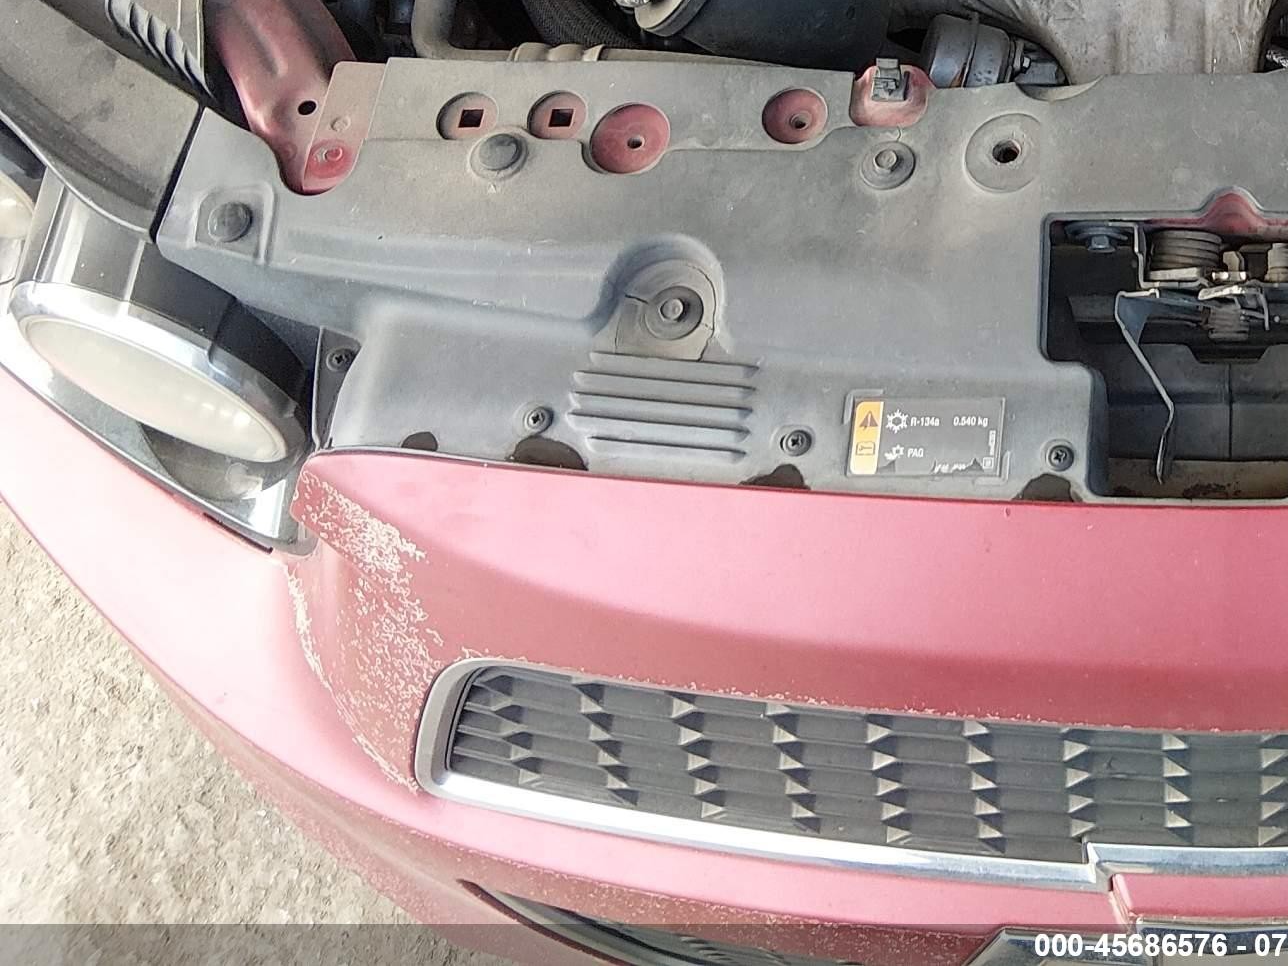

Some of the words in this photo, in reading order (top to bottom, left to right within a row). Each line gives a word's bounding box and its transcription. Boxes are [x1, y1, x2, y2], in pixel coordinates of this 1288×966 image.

[910, 417, 940, 427] R-134a
[953, 416, 976, 427] 0.540
[977, 416, 989, 429] kg
[907, 447, 924, 458] PAG
